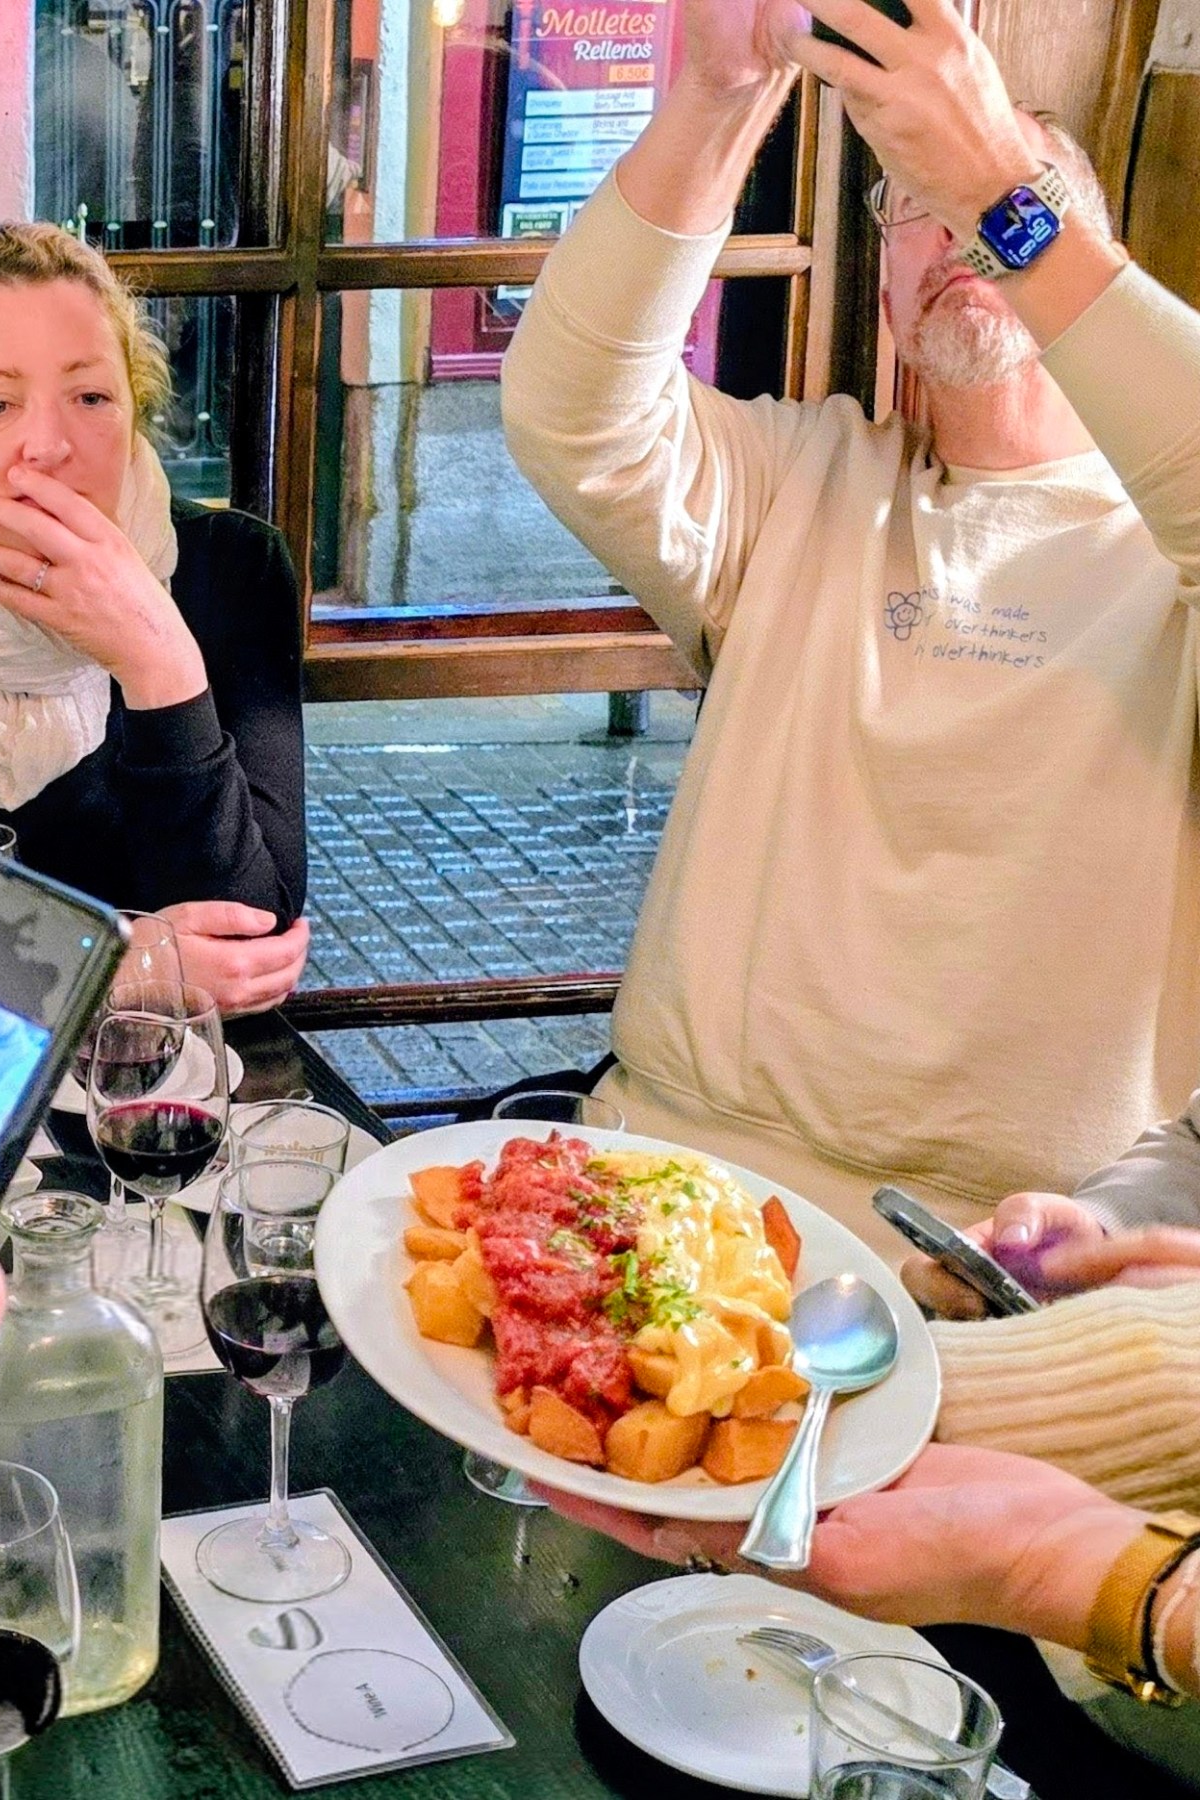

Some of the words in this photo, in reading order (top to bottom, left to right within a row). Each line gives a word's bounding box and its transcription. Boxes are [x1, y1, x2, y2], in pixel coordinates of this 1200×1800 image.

[535, 8, 656, 37] Molletes
[574, 39, 652, 60] Rellenos
[951, 595, 981, 613] was
[992, 604, 1030, 620] made
[945, 619, 1048, 643] overthinkers
[932, 642, 1045, 668] overthinkers
